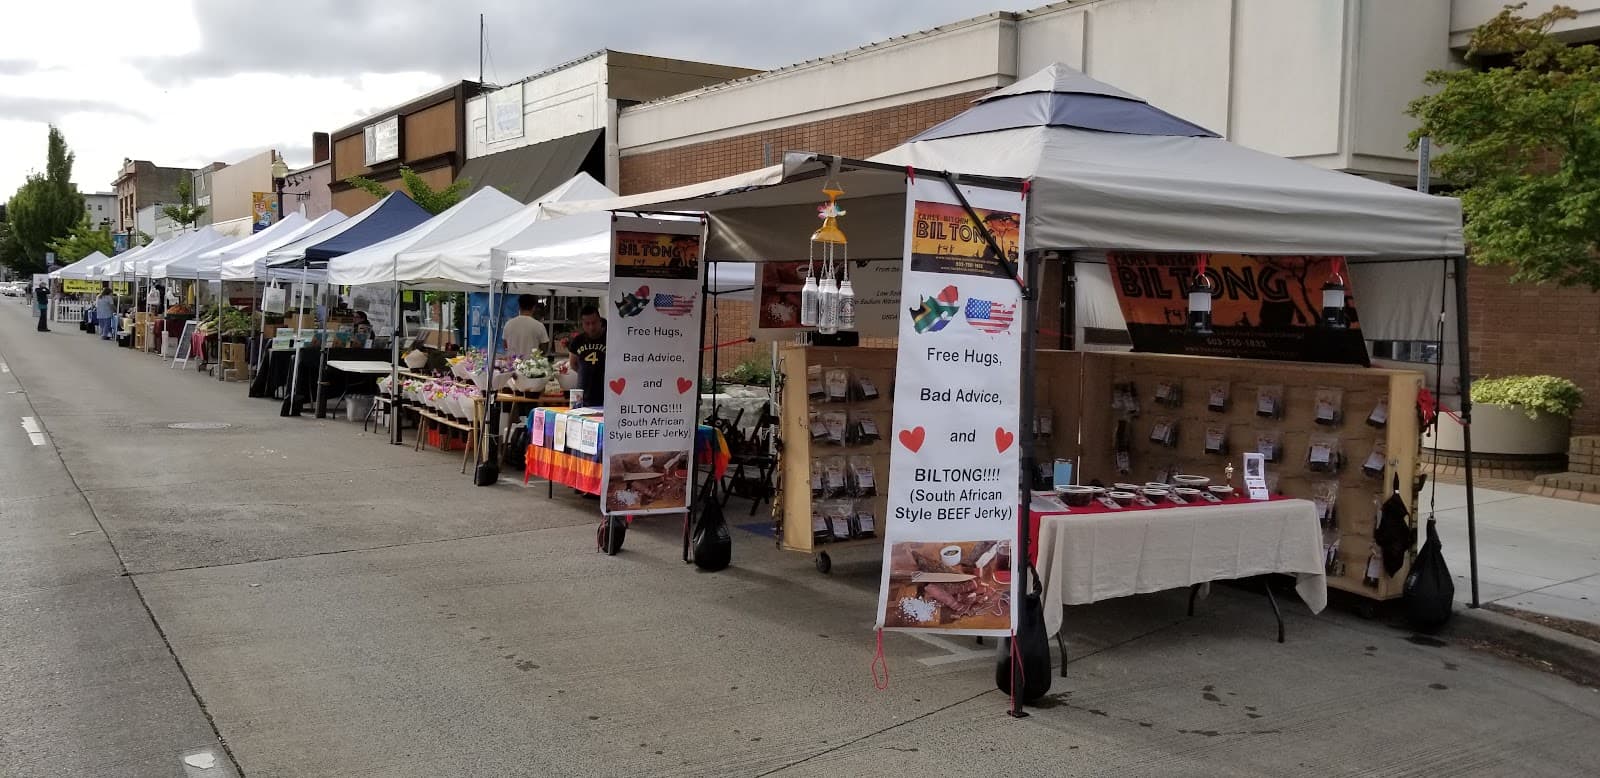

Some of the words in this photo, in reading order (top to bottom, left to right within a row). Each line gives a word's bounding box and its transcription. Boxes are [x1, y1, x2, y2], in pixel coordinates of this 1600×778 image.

[619, 241, 683, 257] BILTONG
[1116, 266, 1291, 301] BILTONG
[627, 326, 651, 336] Free
[654, 326, 683, 337] Hugs,
[584, 351, 599, 365] 4
[623, 353, 644, 362] Bad
[647, 353, 685, 363] Advice,
[927, 347, 959, 361] Free
[964, 348, 1002, 367] Hugs,
[643, 378, 663, 388] and
[920, 388, 951, 402] Bad
[955, 388, 1002, 405] Advice,
[620, 403, 682, 414] BILTONG!!!!
[617, 418, 648, 430] (South
[650, 417, 684, 426] African
[609, 430, 633, 440] Style
[635, 429, 660, 439] BEEF
[662, 428, 691, 439] Jerky)
[950, 429, 976, 443] and
[915, 467, 1000, 482] BILTONG!!!!
[909, 489, 955, 504] (South
[959, 489, 1002, 501] African
[895, 506, 932, 522] Style
[937, 507, 971, 520] BEEF
[974, 506, 1013, 521] Jerky)
